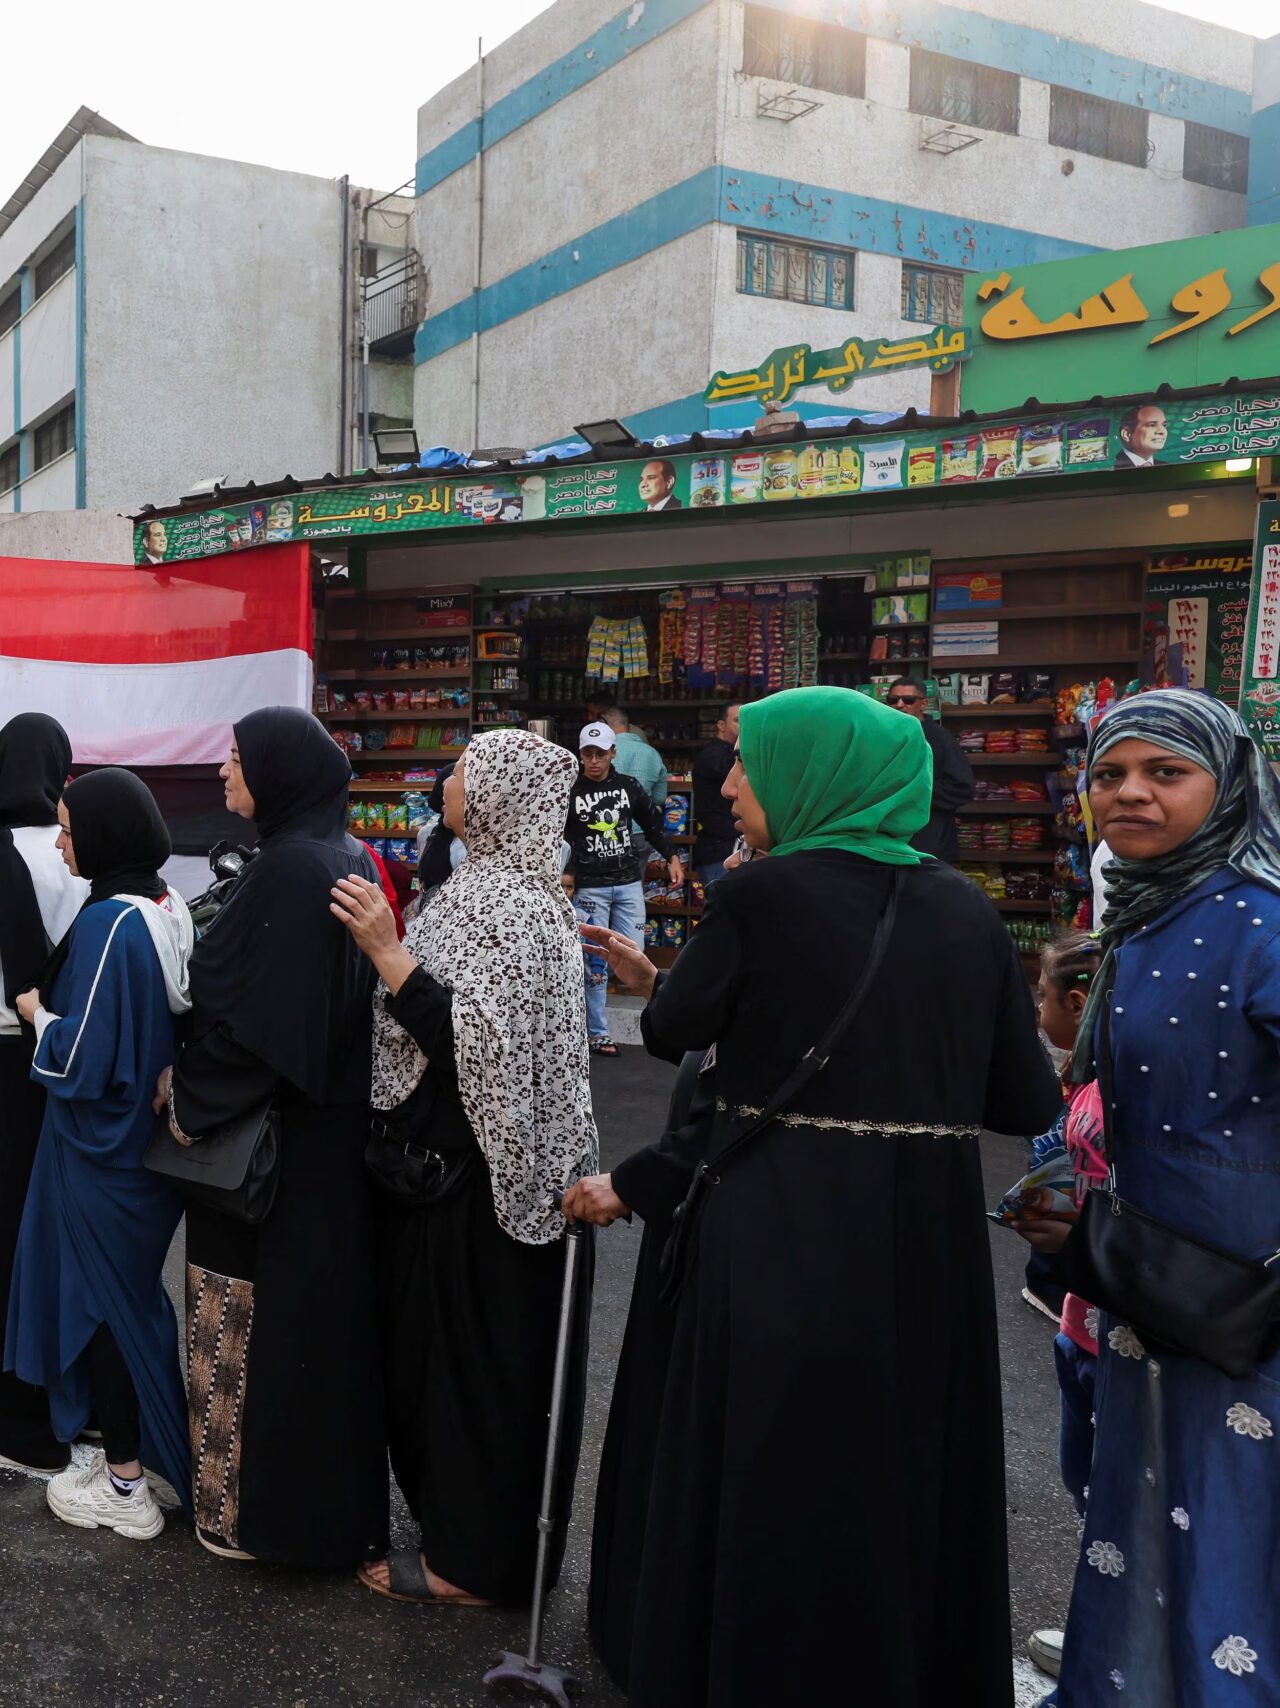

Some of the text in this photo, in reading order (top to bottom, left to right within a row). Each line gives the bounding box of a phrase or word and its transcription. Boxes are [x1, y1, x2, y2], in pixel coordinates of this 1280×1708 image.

[1182, 397, 1280, 423] تحيا مصر
[1180, 416, 1280, 441] تحيا مصر
[1179, 435, 1280, 460] تحيا مصر
[548, 468, 618, 488] تحيا مصر
[548, 483, 618, 503] تحيا مصر
[297, 484, 451, 524] المحروسة
[548, 499, 617, 519] تحيا مصر
[174, 514, 225, 534] تحيا مصر
[302, 525, 352, 537] بالعجوزة
[175, 527, 226, 547] تحيا مصر
[176, 540, 227, 560] تحيا مصر
